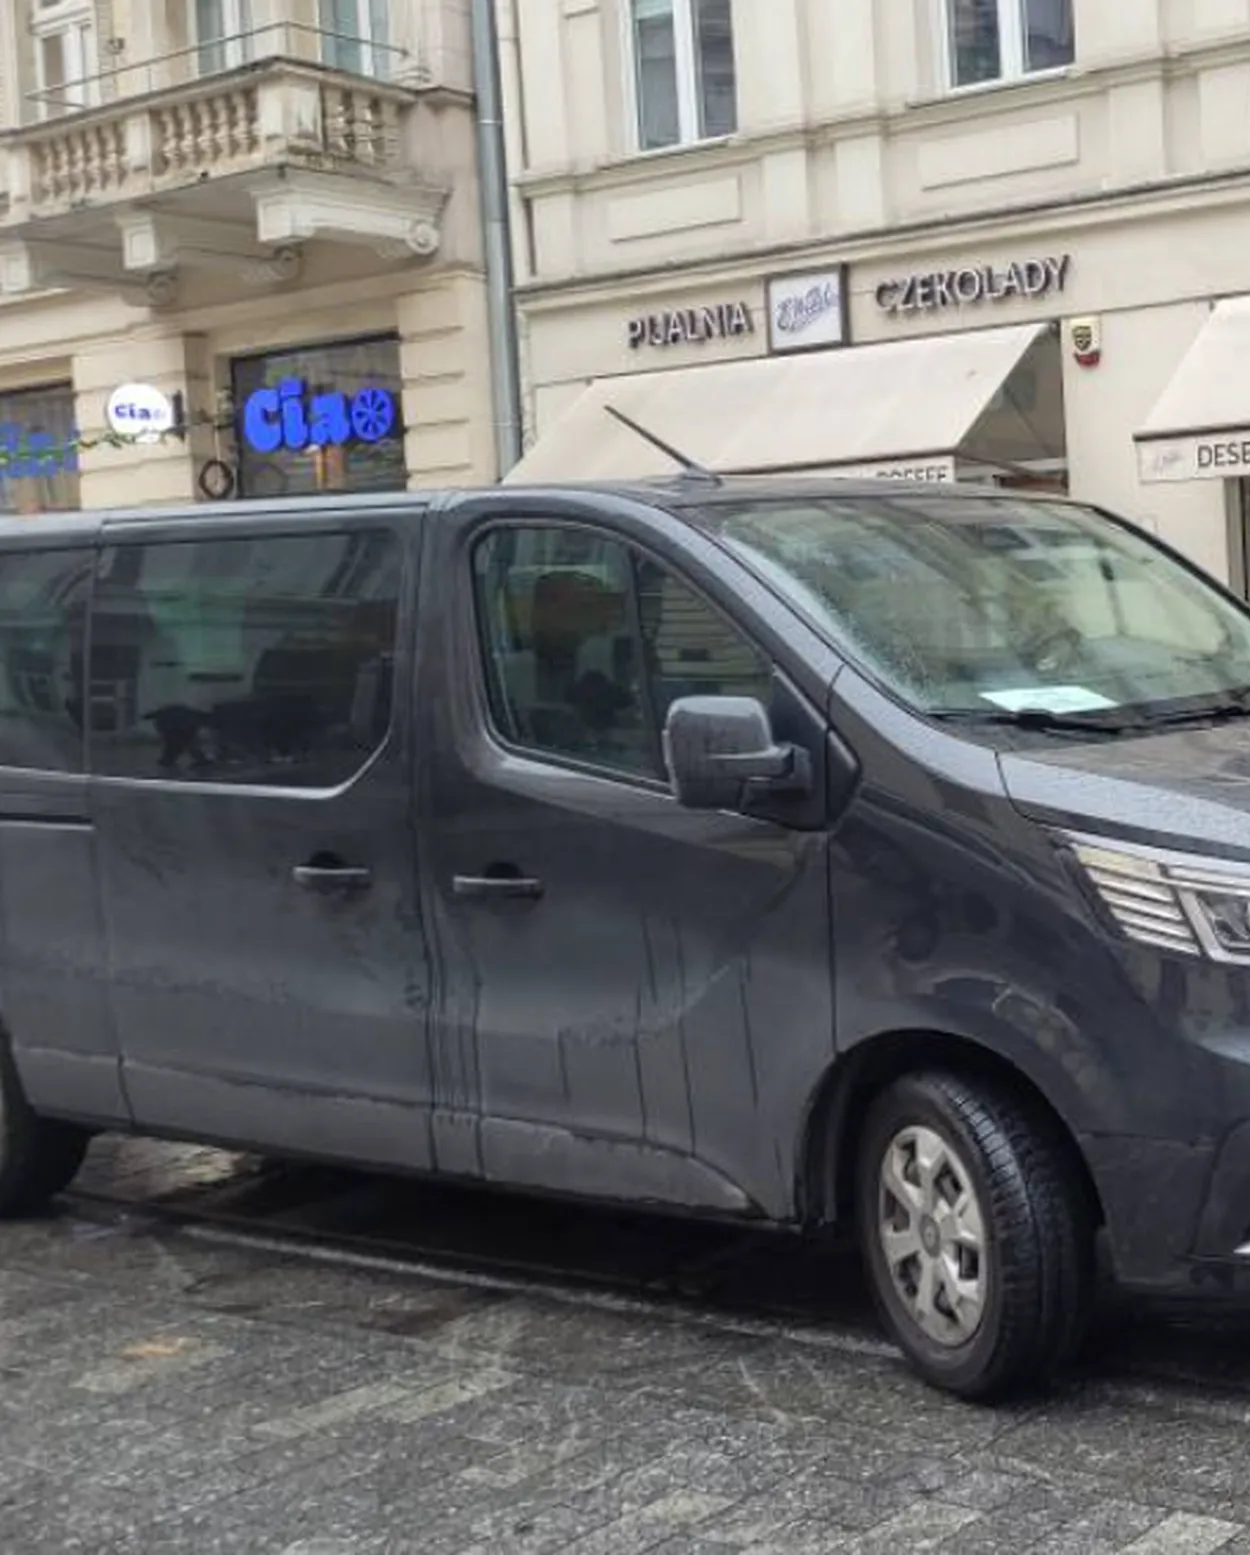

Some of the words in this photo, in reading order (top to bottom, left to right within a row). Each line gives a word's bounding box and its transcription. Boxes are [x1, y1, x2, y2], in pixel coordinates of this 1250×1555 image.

[875, 254, 1071, 313] CZEKOLADY
[628, 300, 755, 349] PIJALNIA
[244, 374, 395, 451] Ciao
